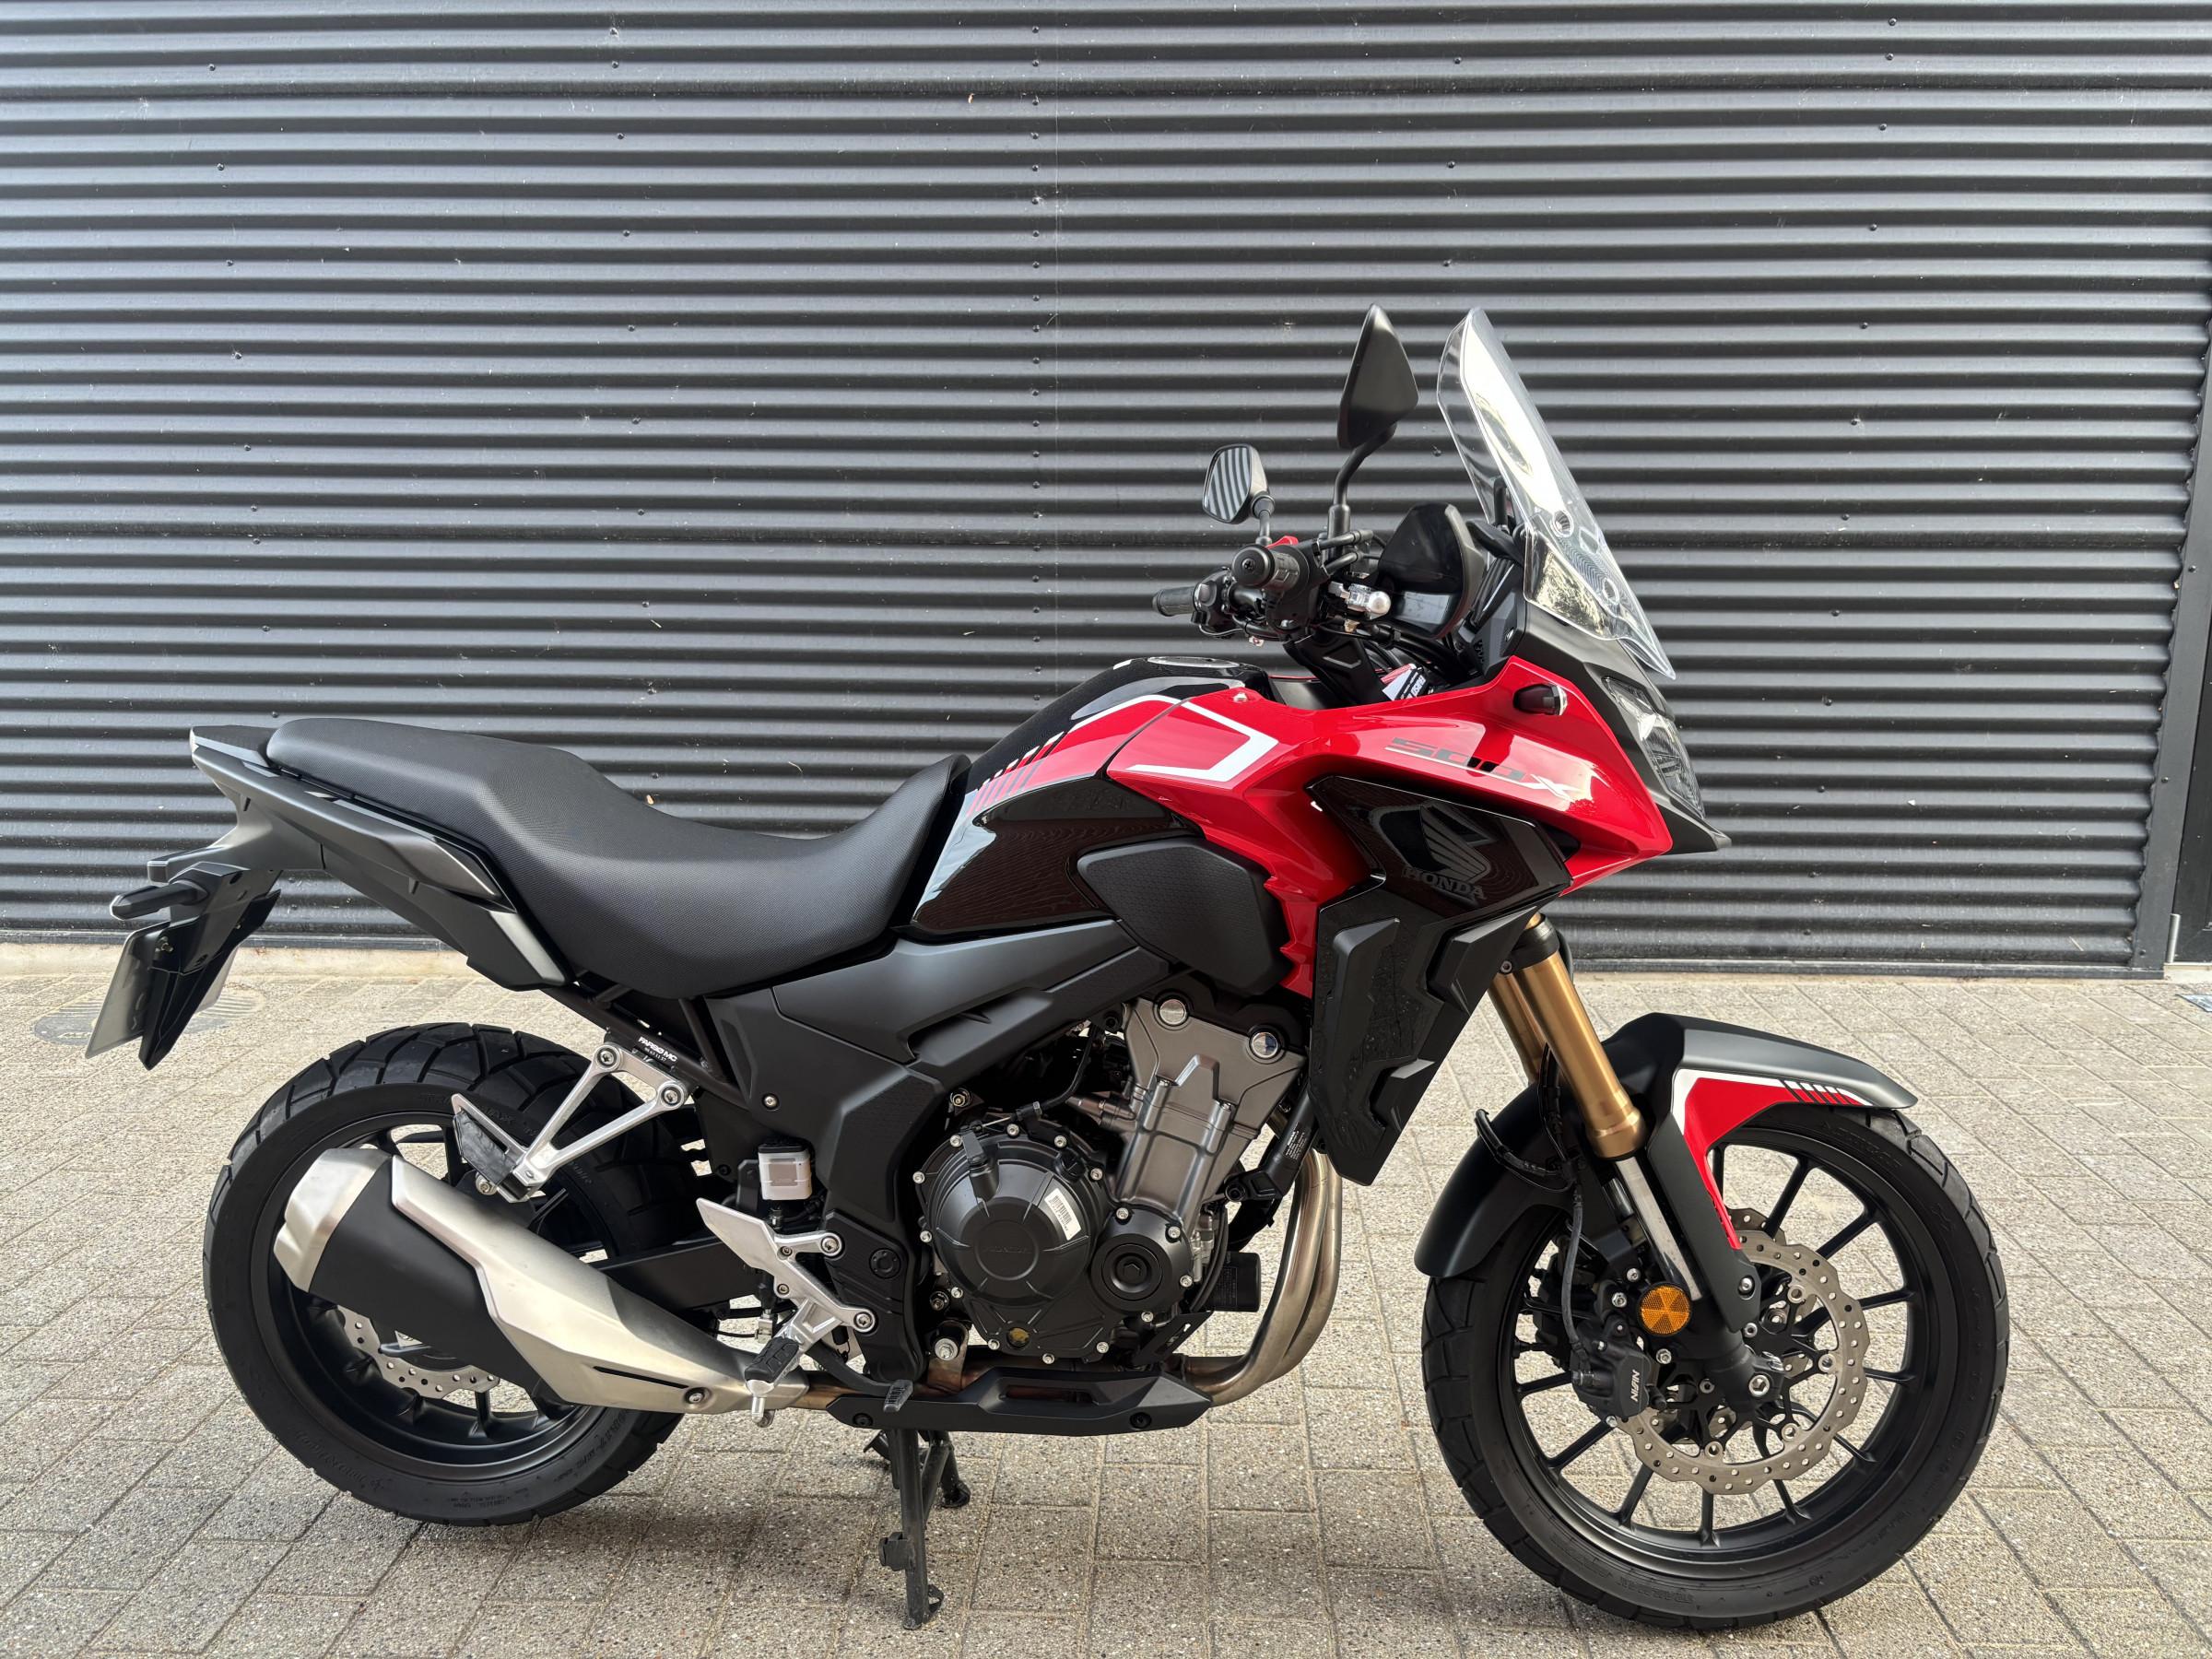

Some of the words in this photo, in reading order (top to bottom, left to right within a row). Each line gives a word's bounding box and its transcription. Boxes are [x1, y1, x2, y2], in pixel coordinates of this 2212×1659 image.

[1385, 737, 1579, 801] 500X
[1402, 867, 1486, 900] HONDA
[664, 1051, 678, 1063] MC
